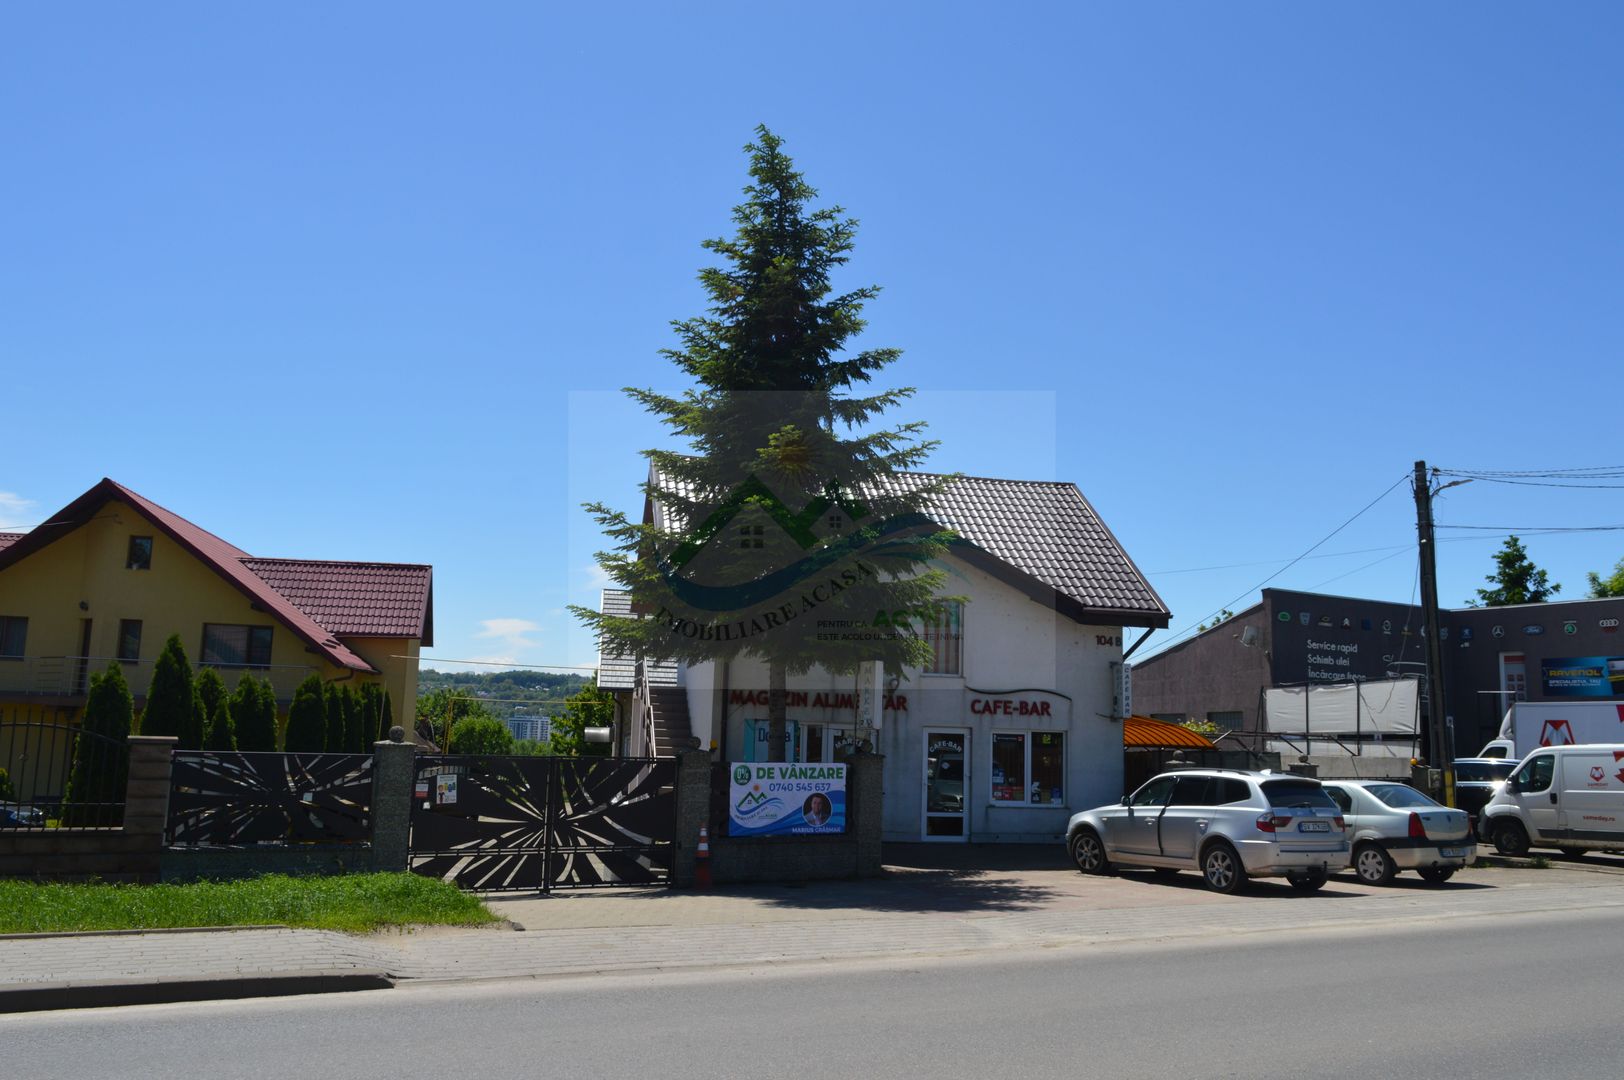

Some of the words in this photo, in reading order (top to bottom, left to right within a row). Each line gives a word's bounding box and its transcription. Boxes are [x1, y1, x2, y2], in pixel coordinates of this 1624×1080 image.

[1096, 634, 1114, 647] 104
[1307, 639, 1336, 651] Service
[1337, 643, 1358, 654] rapid
[1306, 653, 1335, 665] Schimb
[1336, 657, 1350, 666] ulei
[1548, 668, 1601, 677] RAVENOL
[729, 690, 808, 708] MAGZIN
[970, 699, 1052, 717] CAFE-BAR
[929, 740, 962, 753] CAFE-BAR
[756, 767, 775, 780] DE
[779, 763, 844, 780] VÂNZARE
[769, 783, 793, 792] 0740
[795, 783, 813, 792] 545
[815, 783, 831, 792] 637
